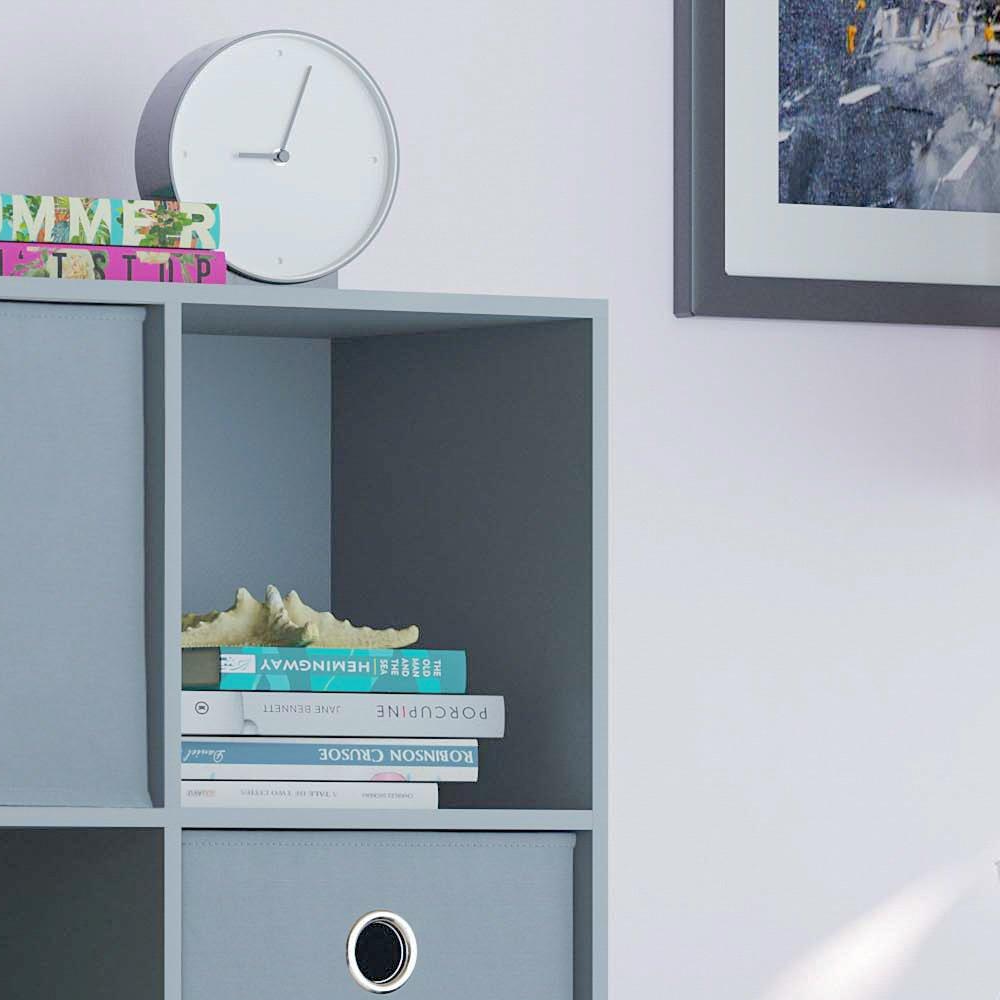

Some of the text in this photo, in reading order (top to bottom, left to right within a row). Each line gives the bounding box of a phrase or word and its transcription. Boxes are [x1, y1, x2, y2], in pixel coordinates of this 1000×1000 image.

[260, 658, 370, 673] HEMINGWAY
[380, 658, 389, 676] SEA
[391, 658, 400, 676] THE
[401, 657, 410, 677] AND
[411, 658, 420, 678] MAN
[422, 658, 431, 677] OLD
[433, 659, 442, 678] THE
[263, 705, 341, 714] JANE BENNETT
[377, 704, 488, 720] PORCUPINE
[319, 747, 474, 764] ROBINSON CRUSOE
